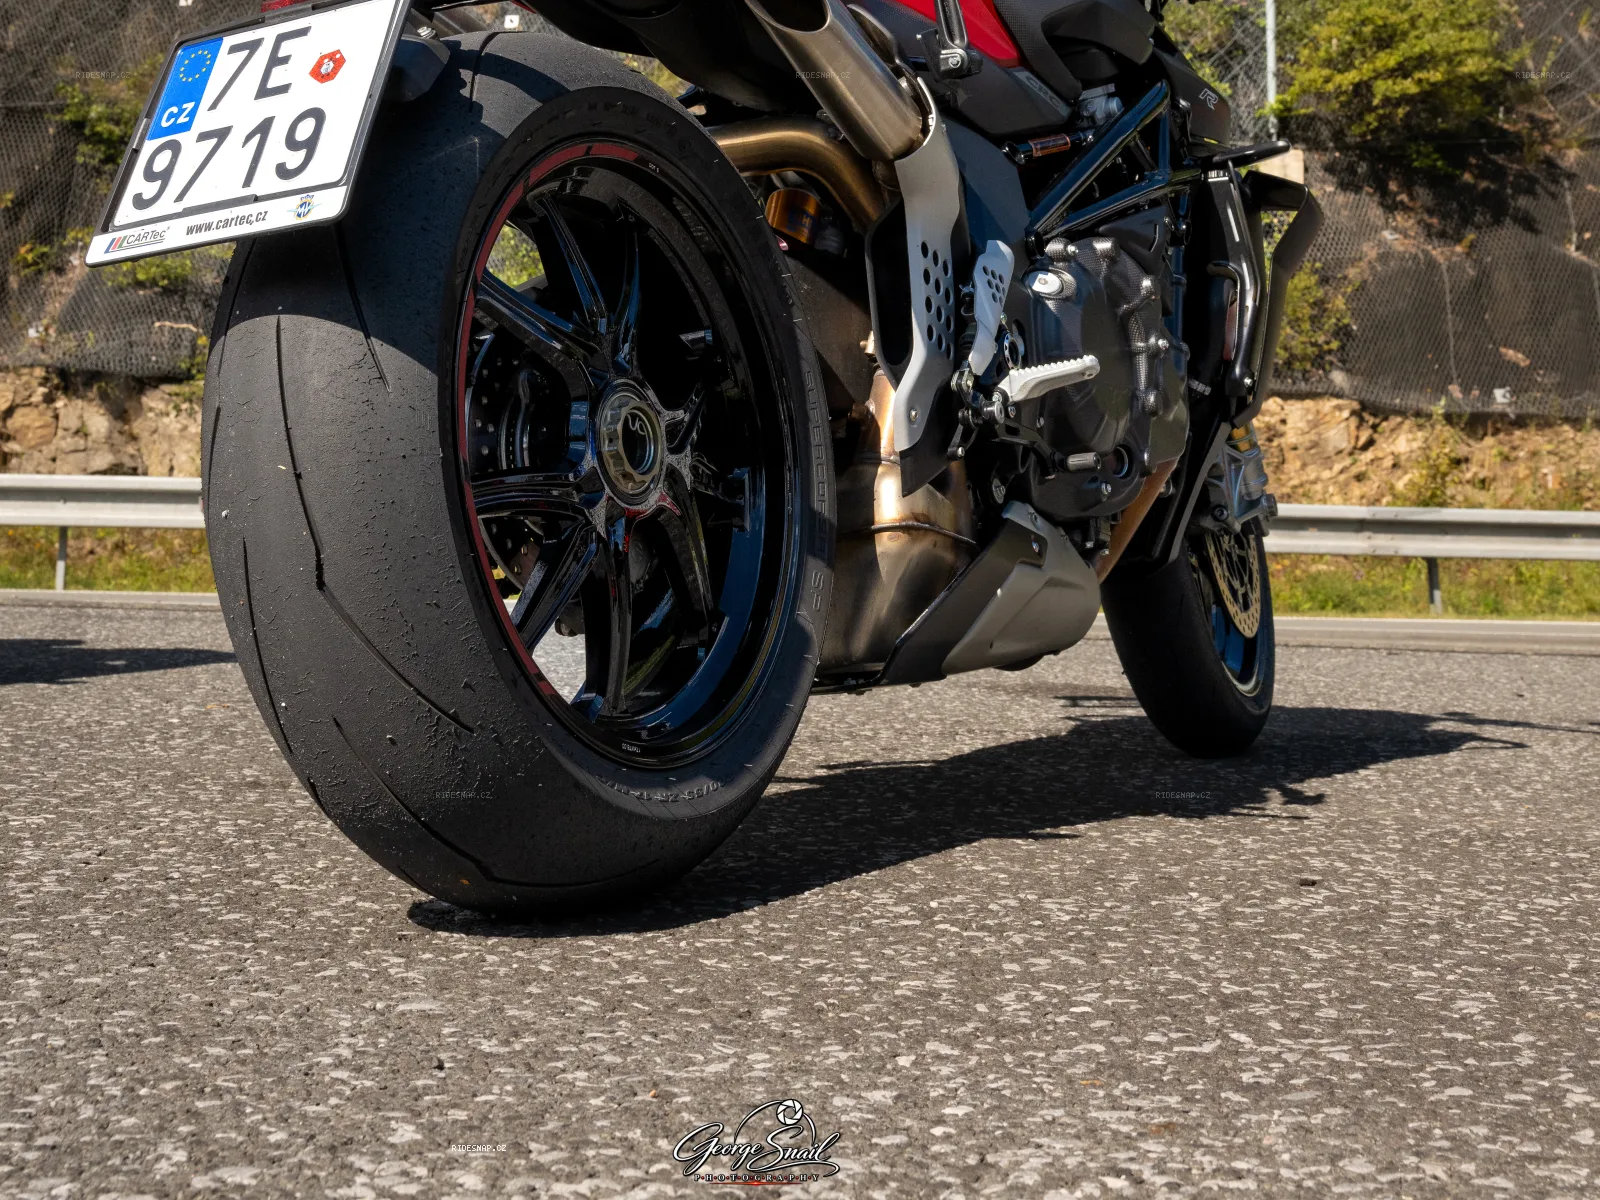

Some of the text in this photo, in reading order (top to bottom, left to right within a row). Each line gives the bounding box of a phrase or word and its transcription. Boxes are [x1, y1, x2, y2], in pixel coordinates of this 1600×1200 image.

[207, 26, 312, 112] 7E
[160, 101, 196, 128] CZ
[132, 106, 327, 211] 9719
[126, 229, 167, 244] CARTec
[186, 210, 268, 236] www.cartec.cz
[803, 370, 829, 612] SUPERCORSA SP
